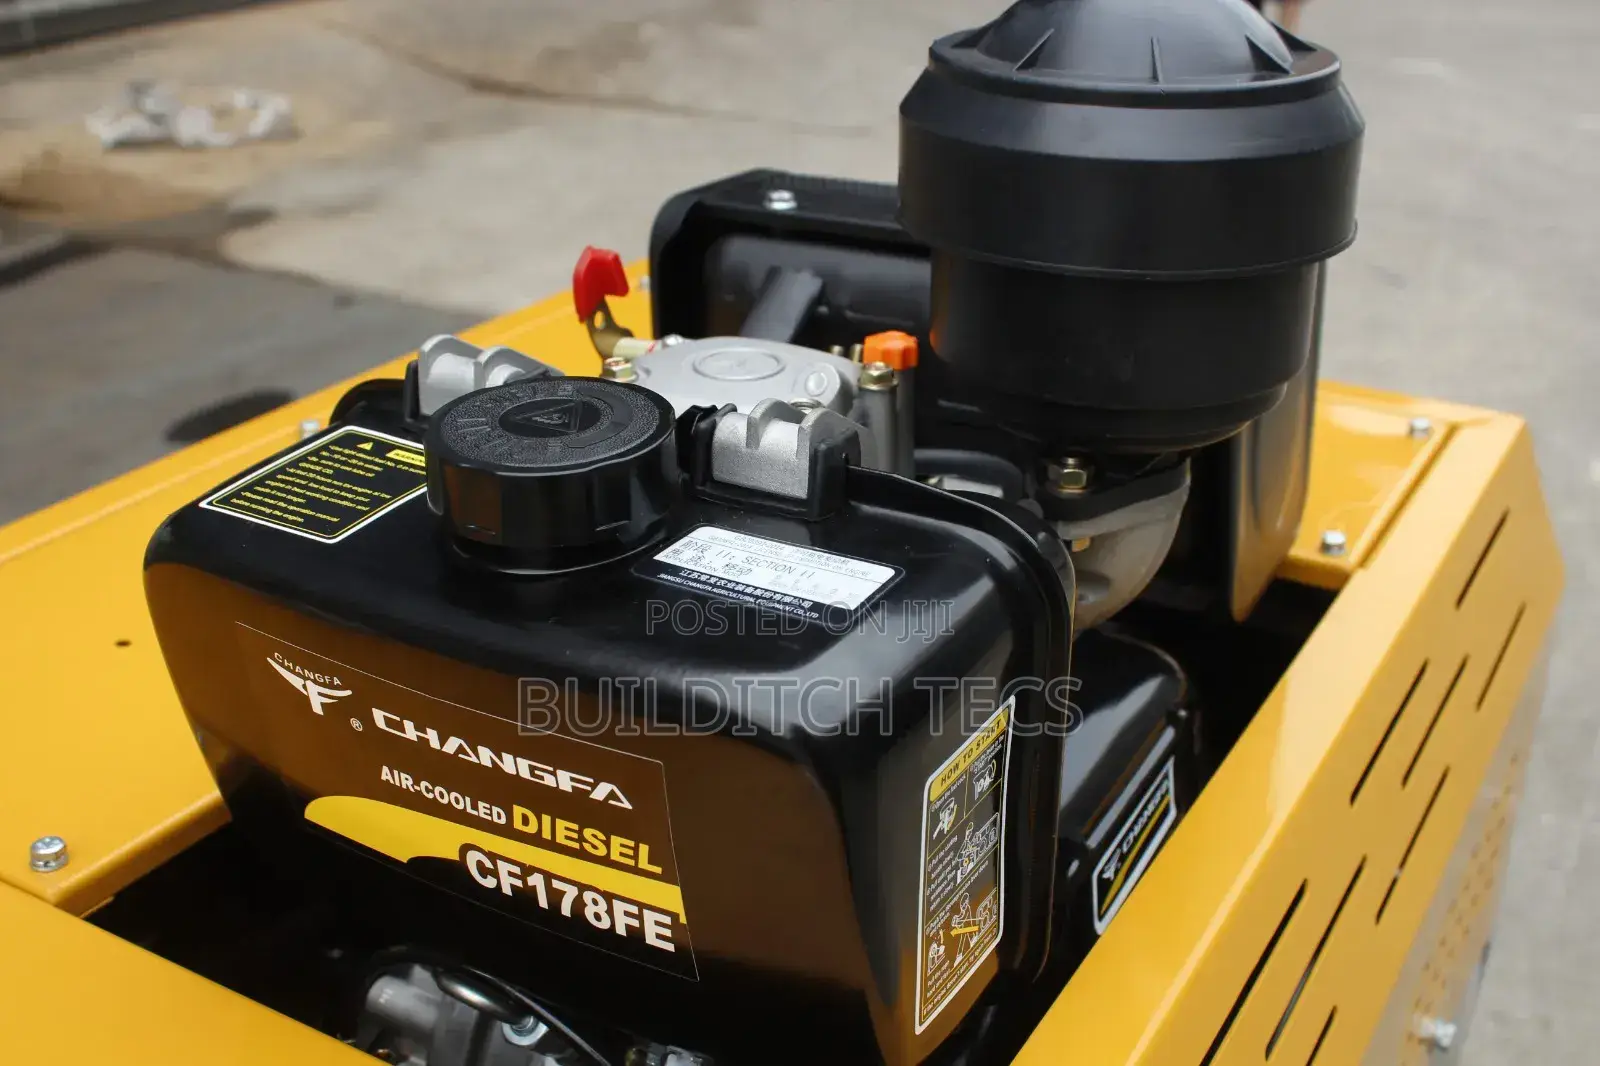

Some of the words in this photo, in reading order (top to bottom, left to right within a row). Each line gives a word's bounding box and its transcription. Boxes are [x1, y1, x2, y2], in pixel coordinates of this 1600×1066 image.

[740, 556, 797, 574] SECTION
[274, 652, 342, 686] CHANGFA
[371, 707, 633, 810] CHANGFA
[940, 762, 961, 786] HOW
[962, 747, 974, 764] TO
[380, 765, 507, 825] AIR-COOLED
[513, 804, 663, 875] DIESEL
[466, 850, 676, 953] CF178FE
